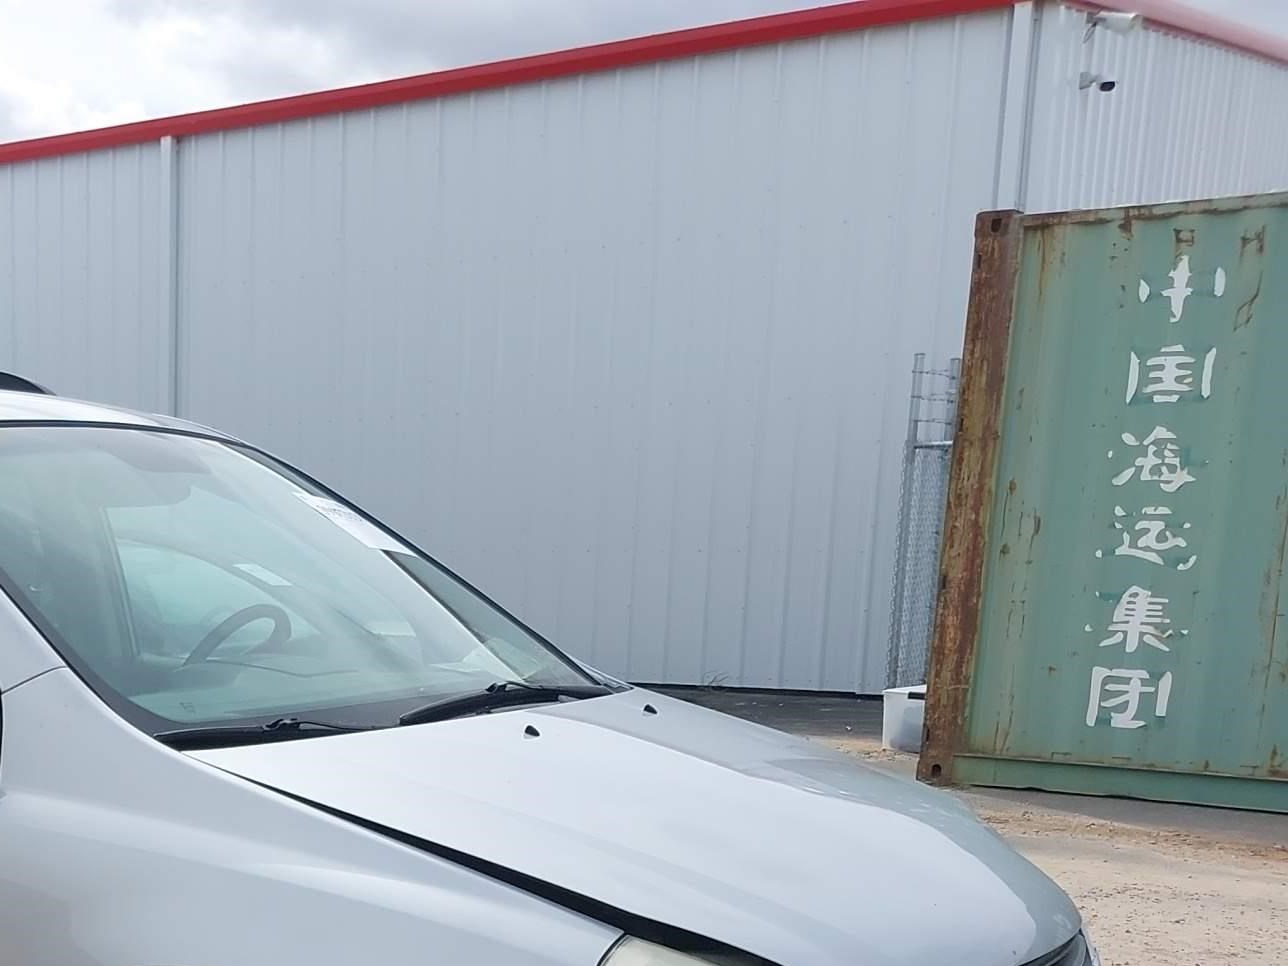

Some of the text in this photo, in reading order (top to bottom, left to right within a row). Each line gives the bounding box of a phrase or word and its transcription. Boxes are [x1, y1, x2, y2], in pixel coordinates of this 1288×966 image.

[1084, 255, 1226, 728] 中国海运集团
